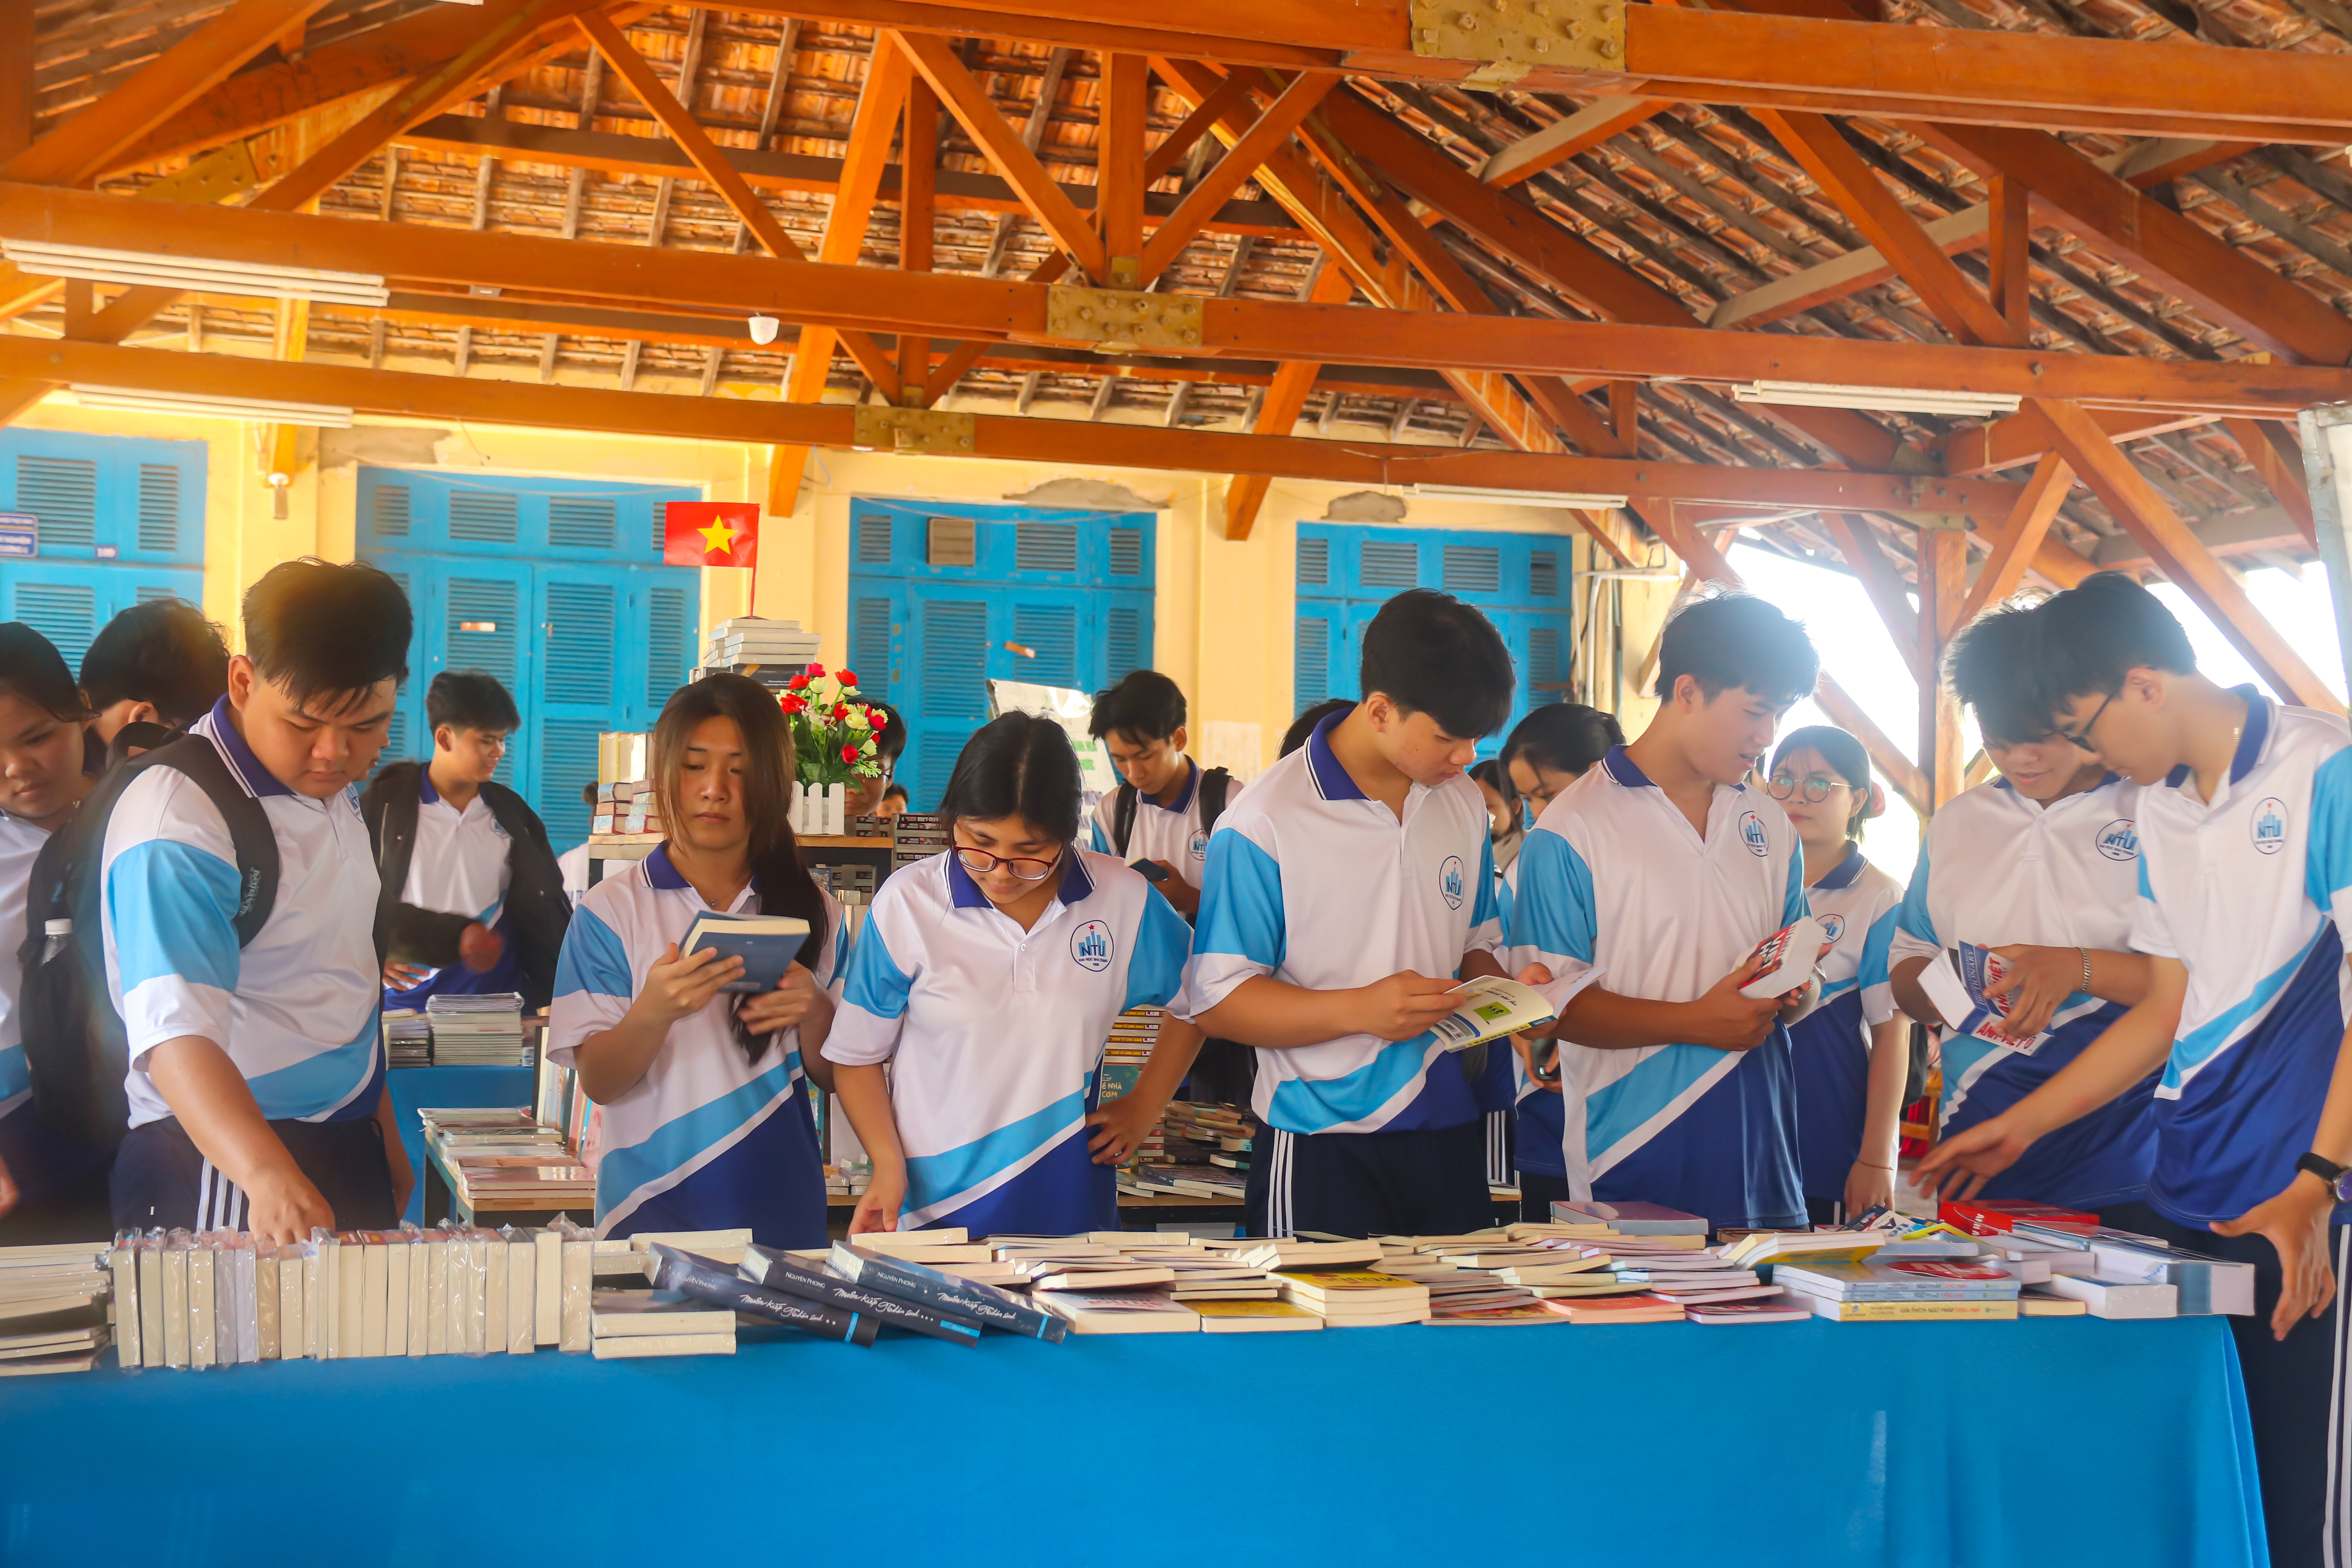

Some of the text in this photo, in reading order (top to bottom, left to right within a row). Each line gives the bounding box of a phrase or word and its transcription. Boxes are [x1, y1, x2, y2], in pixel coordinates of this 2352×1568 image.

[2104, 836, 2134, 849] NTU
[1447, 881, 1460, 895] NTU
[1082, 945, 1104, 956] NTU
[698, 1278, 717, 1290] PHONG
[807, 1277, 825, 1289] PHONG
[898, 1277, 916, 1288] PHONG
